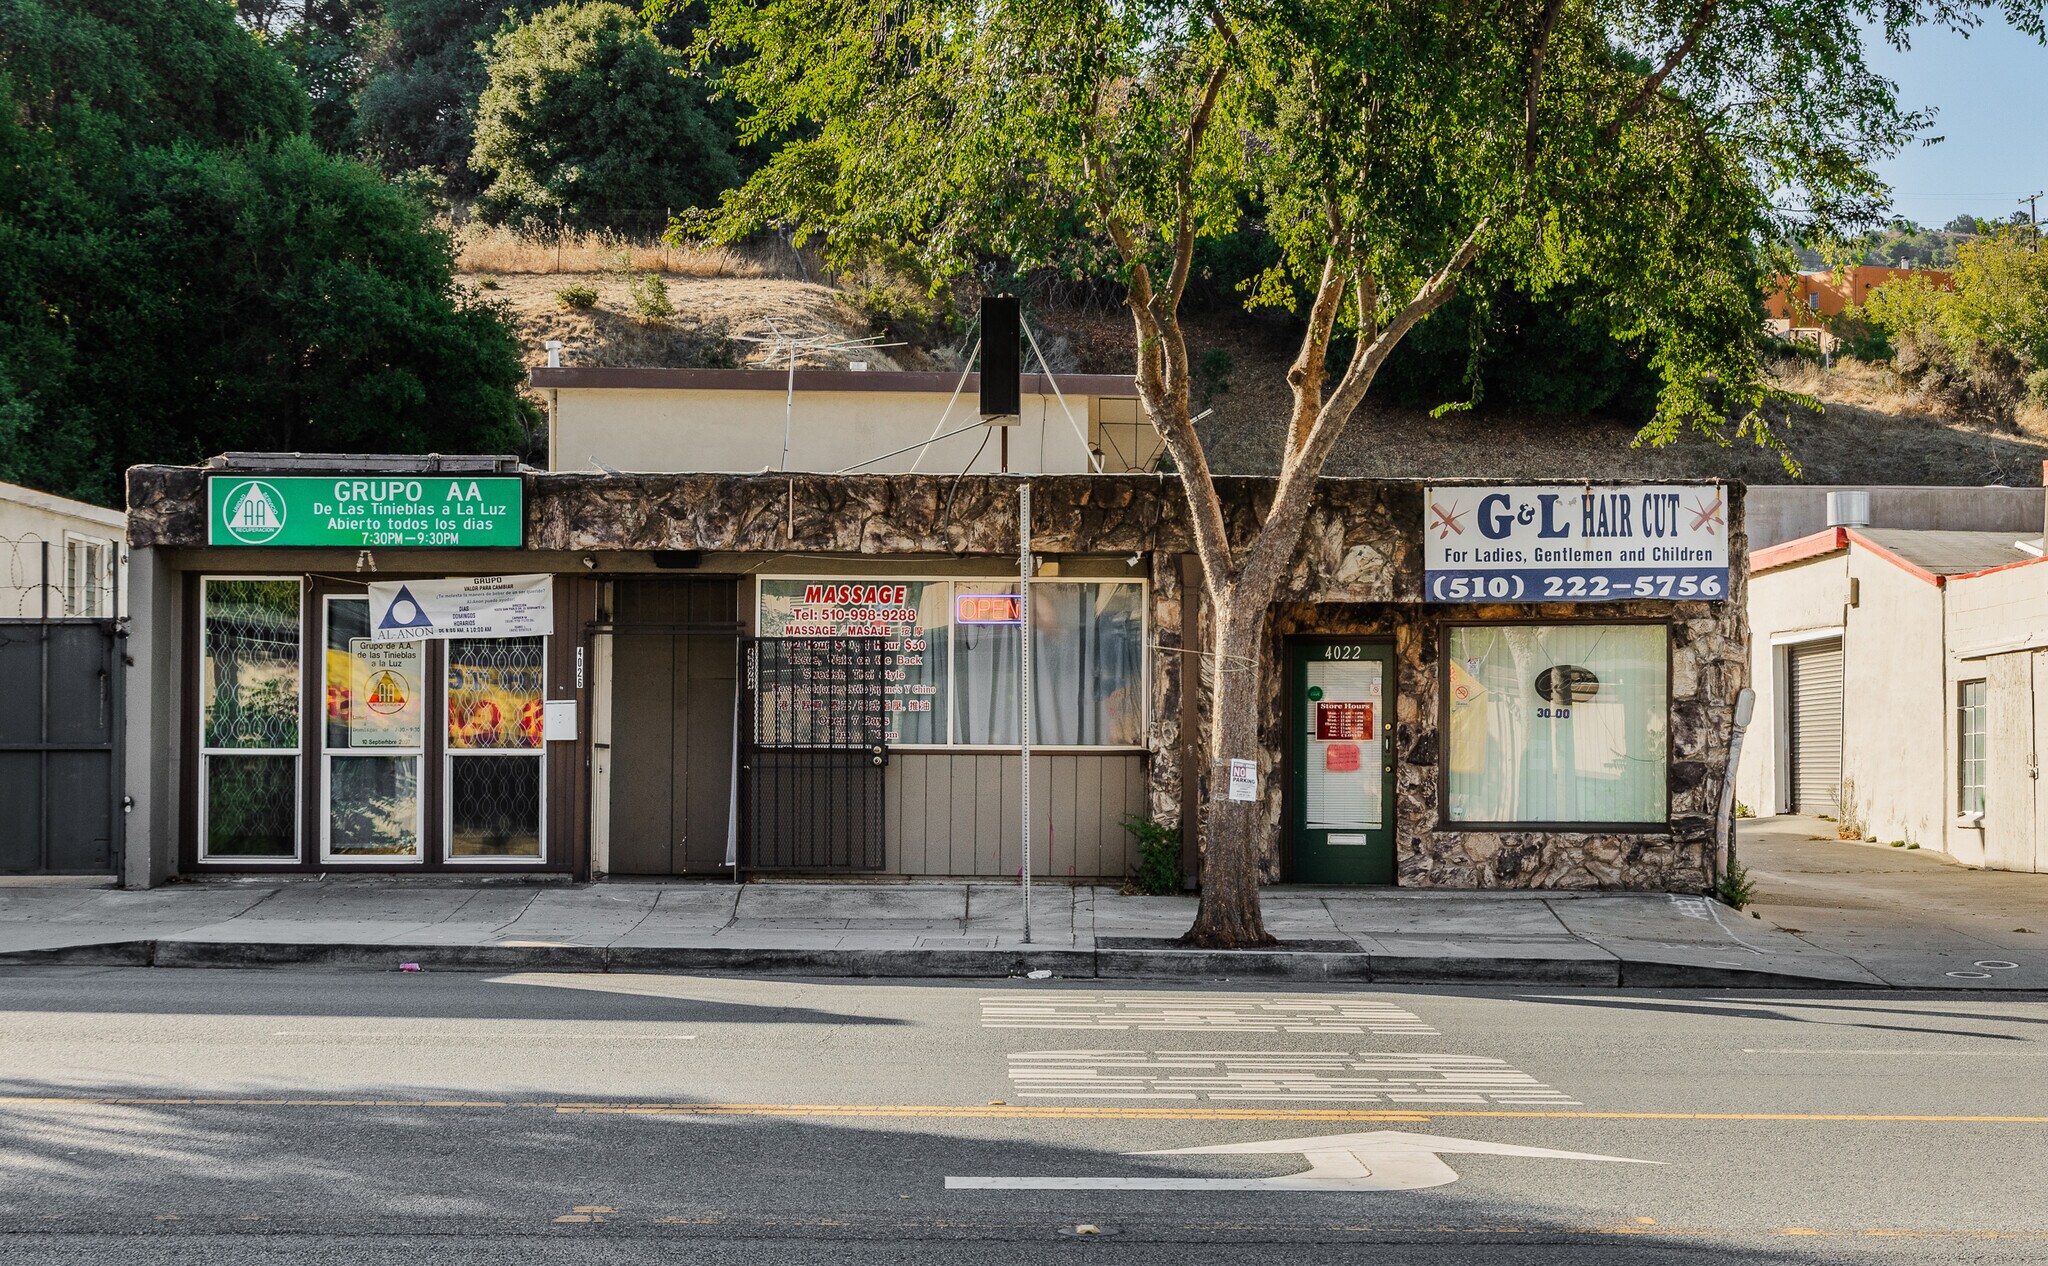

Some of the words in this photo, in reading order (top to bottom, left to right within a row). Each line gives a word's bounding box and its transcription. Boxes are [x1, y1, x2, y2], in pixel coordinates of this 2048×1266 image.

[334, 481, 423, 502] GRUPO
[446, 481, 482, 502] AA
[313, 502, 333, 515] De
[339, 502, 365, 515] Las
[371, 502, 435, 515] Tinieblas
[442, 505, 450, 515] a
[457, 502, 474, 515] La
[480, 502, 506, 515] Luz
[1581, 493, 1633, 538] HAIR
[1642, 493, 1680, 538] CUT
[327, 518, 381, 530] Abierto
[388, 518, 429, 530] todos
[435, 518, 457, 530] los
[463, 518, 493, 530] dias
[1445, 548, 1468, 563] For
[1475, 548, 1527, 564] Ladies,
[1534, 547, 1613, 563] Gentlemen
[1619, 547, 1646, 562] and
[1652, 547, 1713, 562] Children
[474, 577, 502, 585] GRUPO
[1433, 575, 1525, 600] (510)
[1543, 575, 1722, 597] 222-5756
[804, 584, 906, 605] MASSAGE
[794, 609, 819, 622] Tel:
[821, 609, 917, 622] 510-998-9288
[959, 599, 1020, 620] OPEN
[377, 628, 434, 640] AL-ANON
[785, 626, 836, 636] MASSAGE
[848, 626, 891, 636] MASAJE
[360, 642, 383, 651] Grupo
[386, 642, 395, 650] de
[398, 642, 414, 650] A.A.
[1325, 645, 1362, 660] 4022
[357, 651, 367, 659] de
[370, 651, 381, 659] las
[384, 651, 417, 659] Tinieblas
[896, 655, 923, 665] Back
[912, 685, 937, 694] Chino
[1233, 766, 1246, 777] NO
